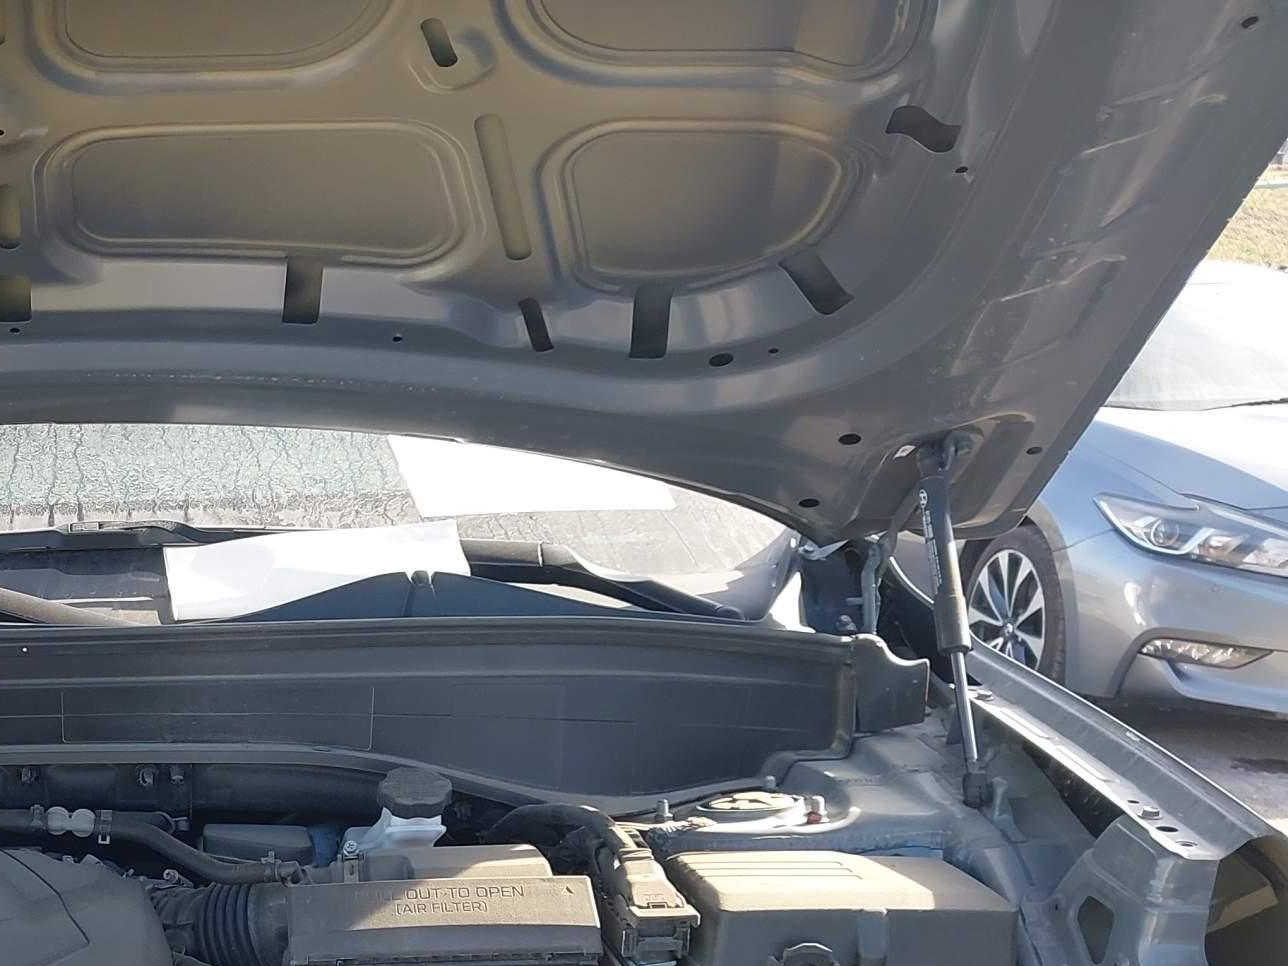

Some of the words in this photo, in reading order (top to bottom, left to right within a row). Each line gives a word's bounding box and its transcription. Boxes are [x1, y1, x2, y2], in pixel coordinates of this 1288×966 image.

[407, 888, 441, 900] OUT
[444, 887, 470, 899] TO
[475, 886, 525, 898] OPEN
[396, 902, 427, 916] (AIR
[432, 900, 488, 914] FILTER)
